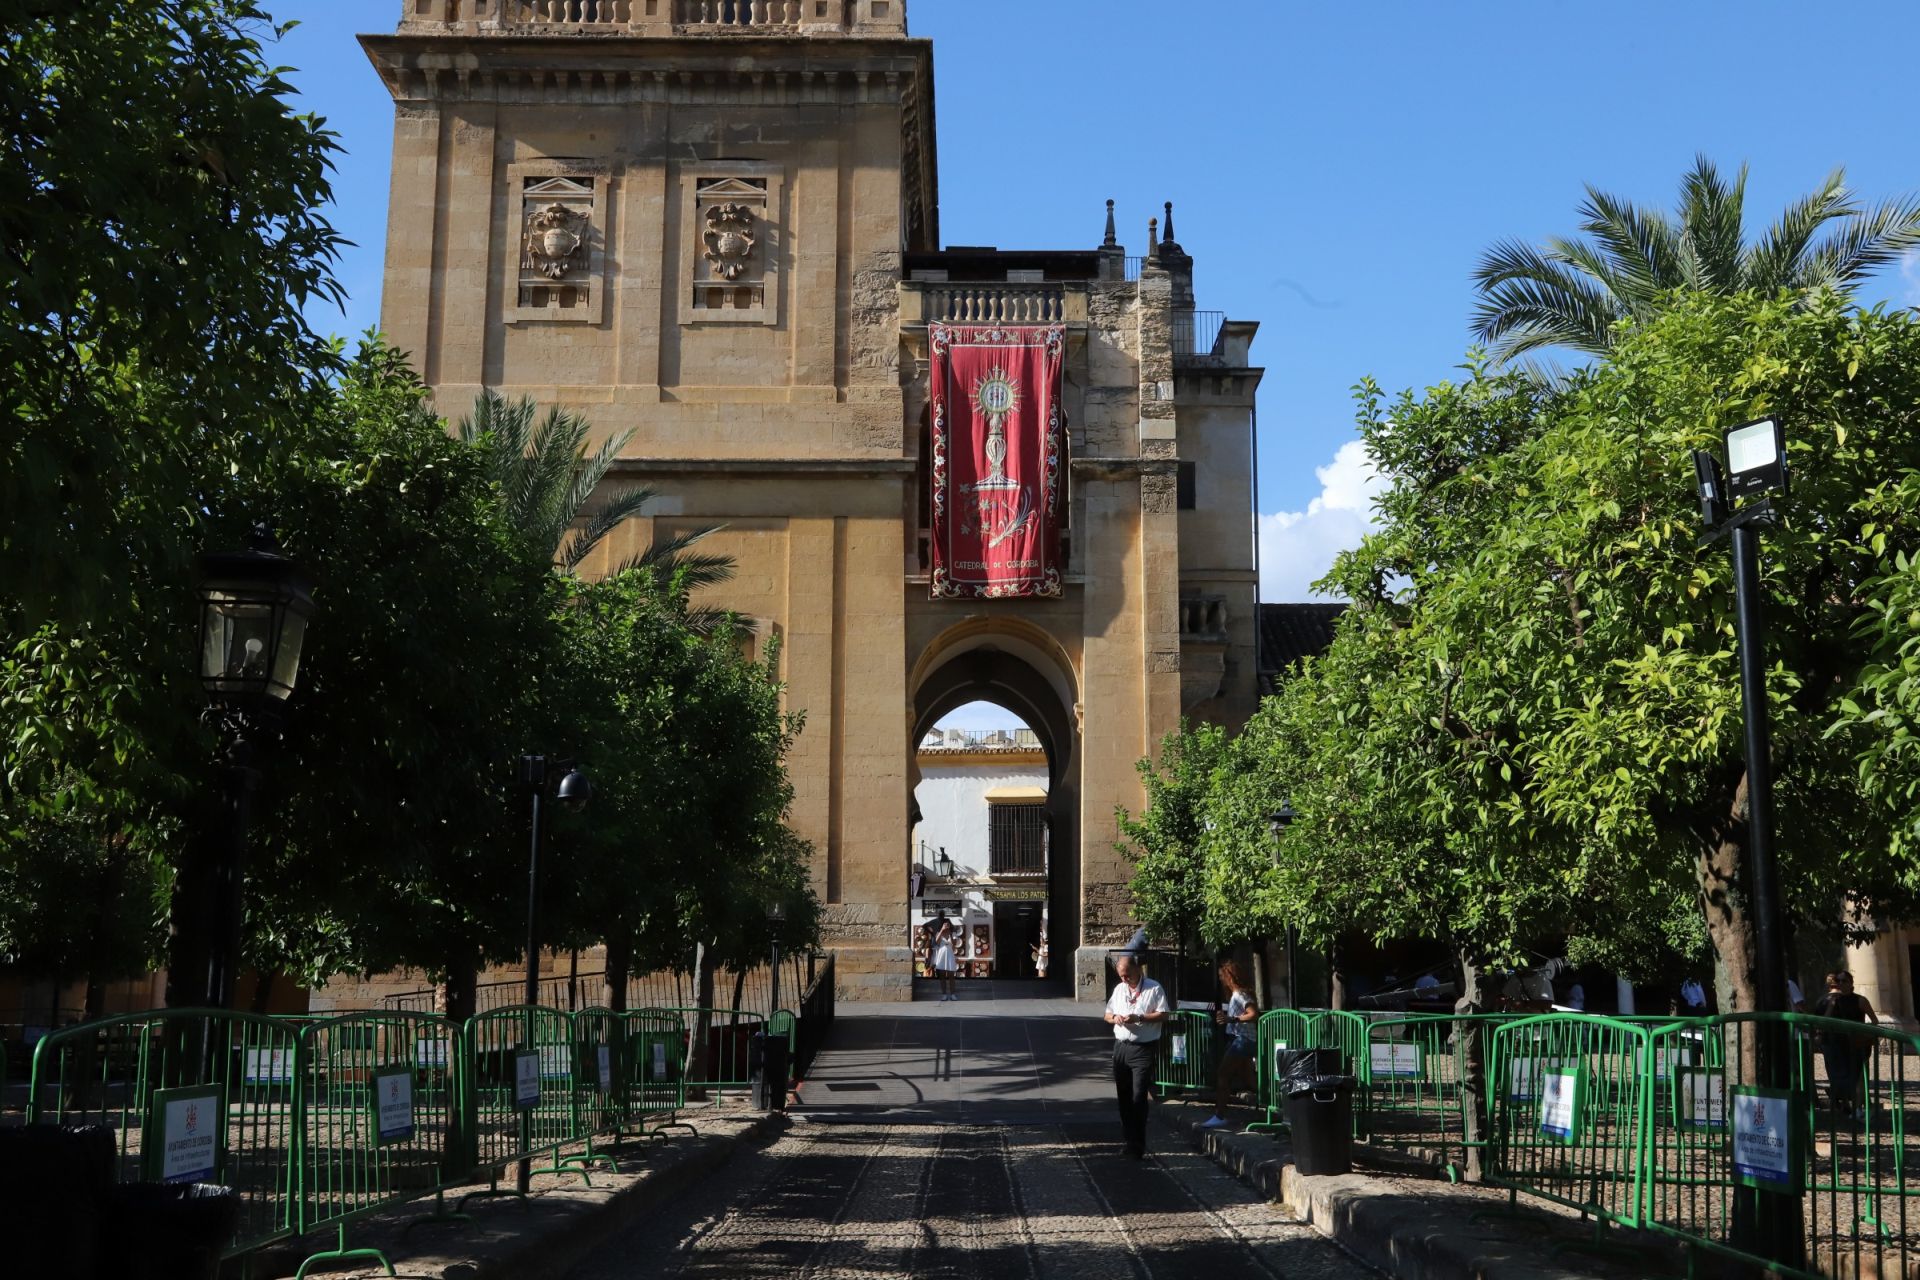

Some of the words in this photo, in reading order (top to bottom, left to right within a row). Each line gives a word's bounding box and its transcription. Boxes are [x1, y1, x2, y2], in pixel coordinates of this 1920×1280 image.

[954, 560, 990, 570] CATEDRAL
[1006, 559, 1039, 569] CORDOBA
[1017, 891, 1029, 899] LOS
